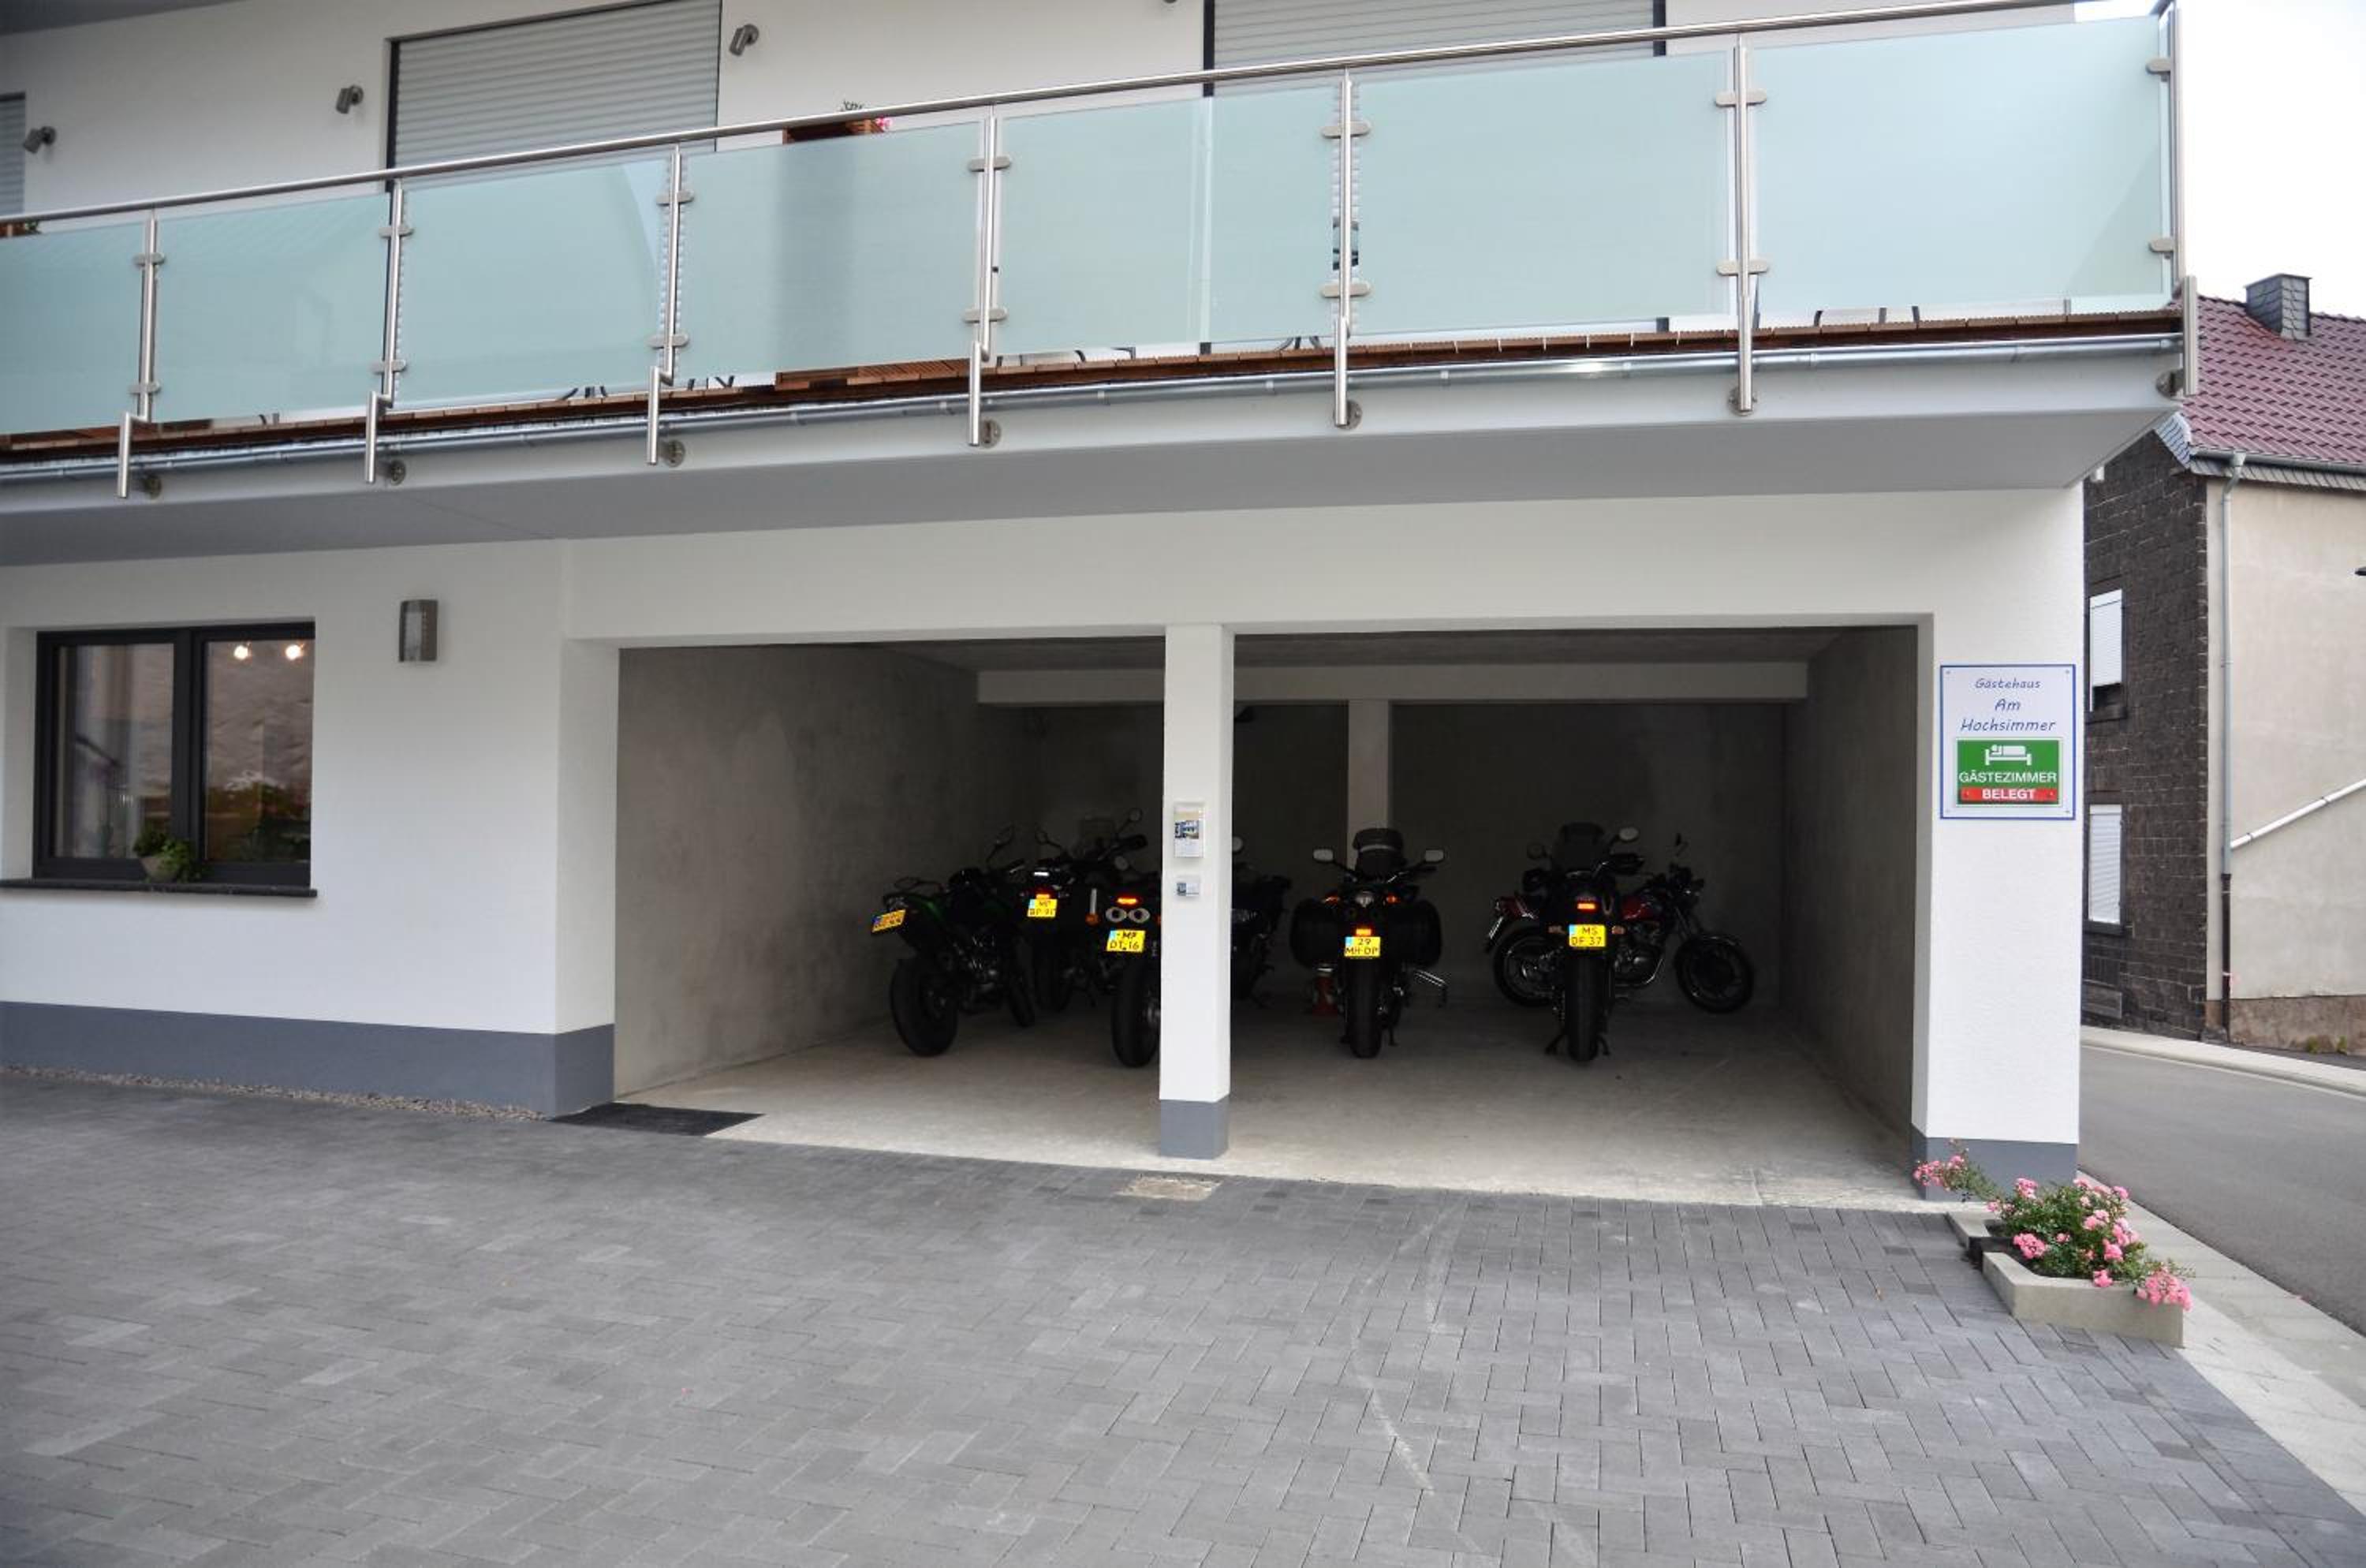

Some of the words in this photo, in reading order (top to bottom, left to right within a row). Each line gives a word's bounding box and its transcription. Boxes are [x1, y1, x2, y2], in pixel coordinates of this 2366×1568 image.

[1995, 698, 2021, 711] Am
[1961, 719, 2056, 731] Hochsimmer
[1958, 769, 2057, 783] GÄSTEZIMMER
[1982, 790, 2036, 800] BELEGT
